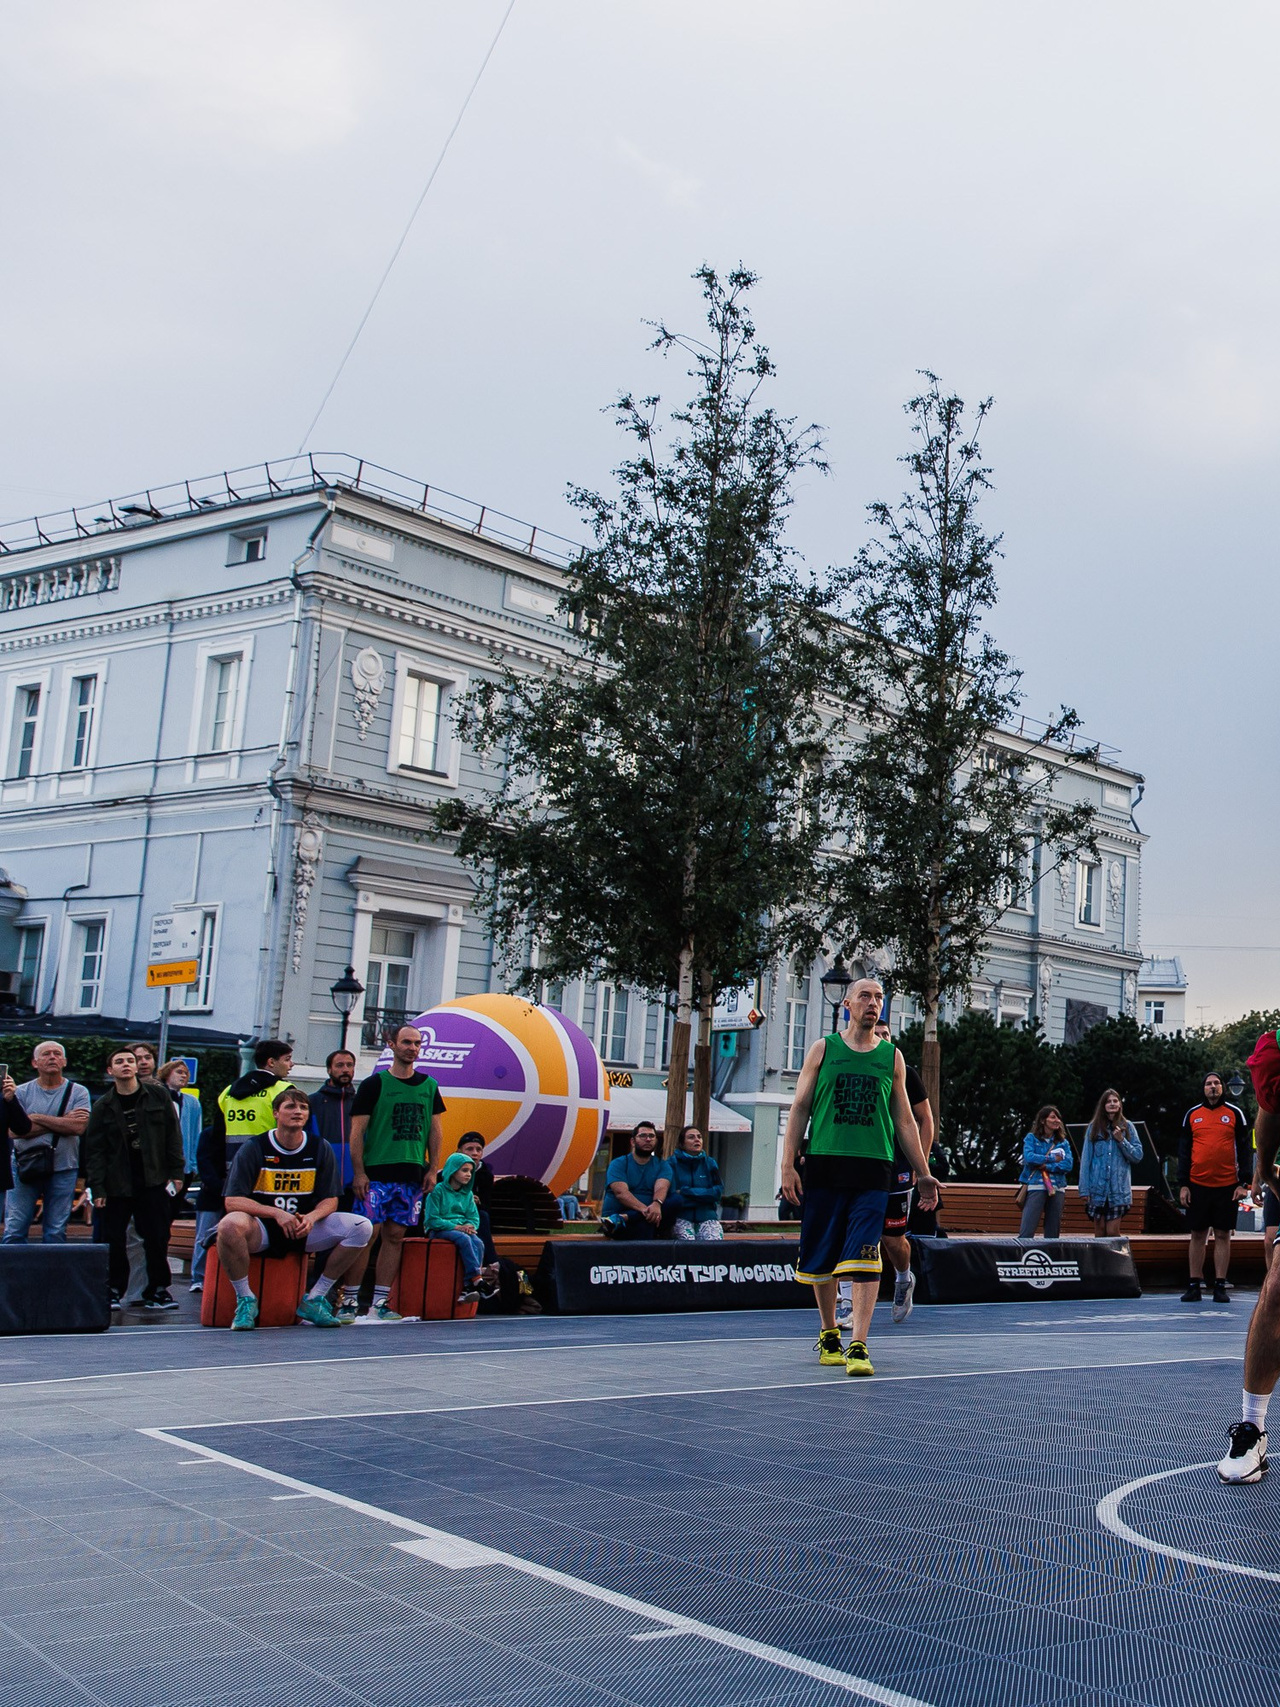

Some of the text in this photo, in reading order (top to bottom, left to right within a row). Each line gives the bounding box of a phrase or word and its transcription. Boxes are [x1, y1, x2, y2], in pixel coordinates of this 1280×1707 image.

[836, 1073, 880, 1091] СТРИТ
[833, 1089, 880, 1104] БАСКЕТ
[227, 1109, 256, 1122] 936
[274, 1196, 299, 1214] 96
[688, 1265, 728, 1283] ТУР
[729, 1264, 797, 1284] МОСКВА
[997, 1266, 1080, 1277] STREETBASKET
